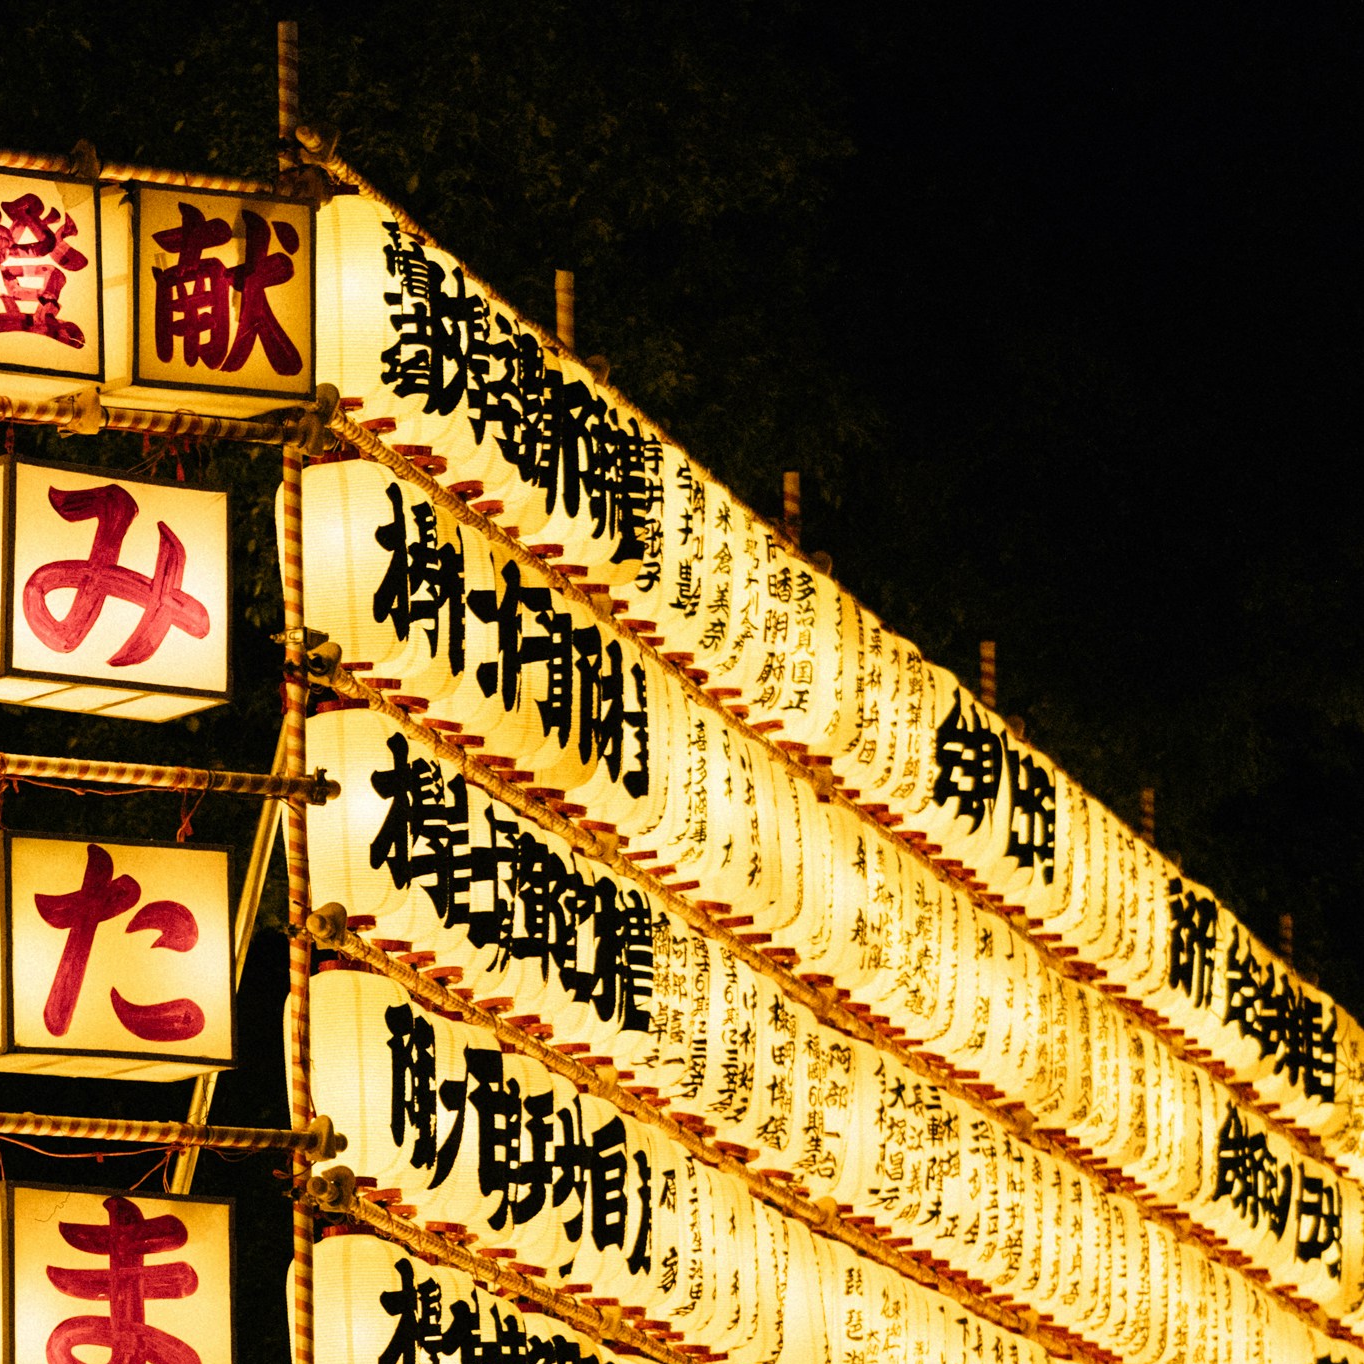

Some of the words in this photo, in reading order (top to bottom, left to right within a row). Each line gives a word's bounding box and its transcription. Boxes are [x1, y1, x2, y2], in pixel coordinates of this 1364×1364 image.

[151, 201, 303, 377] 献
[22, 483, 211, 668] み
[34, 843, 205, 1042] た
